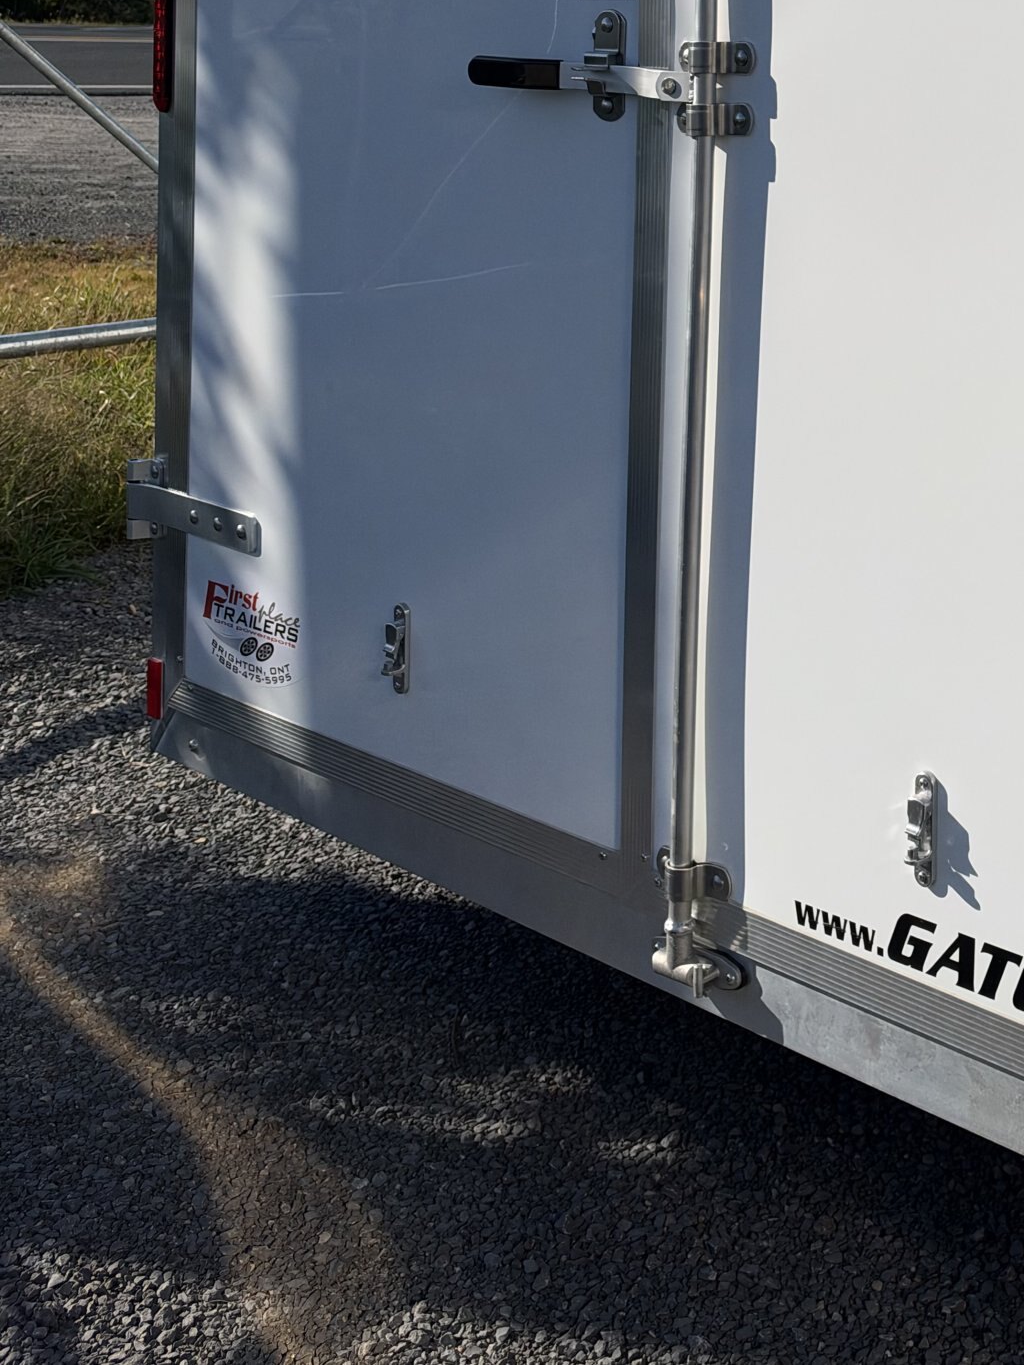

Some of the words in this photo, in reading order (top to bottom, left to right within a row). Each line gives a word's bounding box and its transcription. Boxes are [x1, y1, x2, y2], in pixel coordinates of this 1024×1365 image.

[202, 580, 260, 620] First
[258, 601, 301, 628] place
[213, 602, 299, 643] TRAILERS
[214, 618, 234, 630] and
[235, 625, 297, 649] powersports
[211, 639, 267, 676] BRIGHTON,
[269, 663, 290, 676] ONT
[211, 648, 292, 685] 1-888-475-5995
